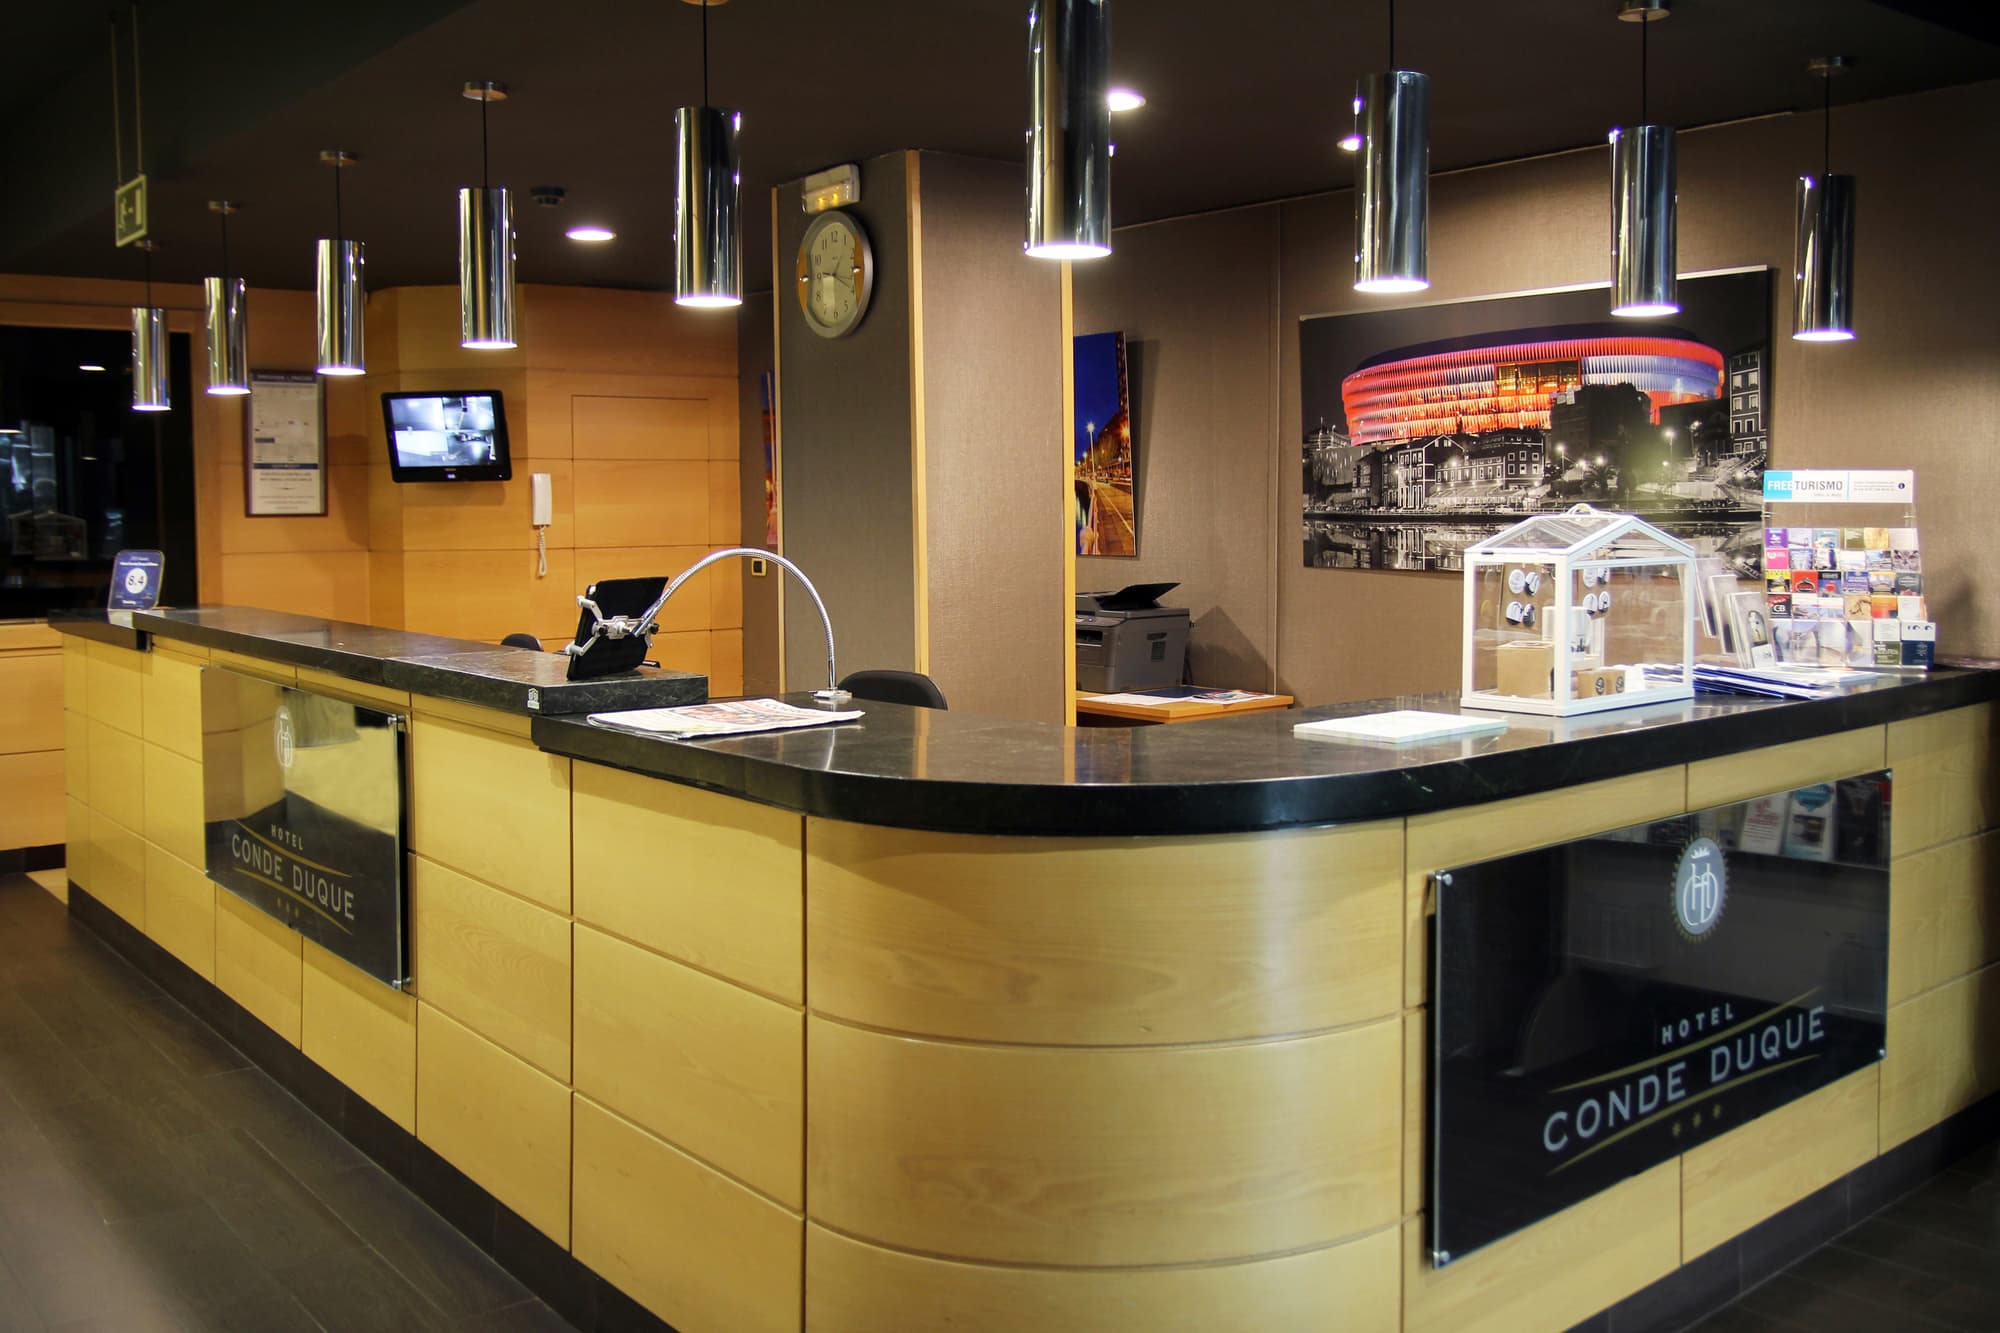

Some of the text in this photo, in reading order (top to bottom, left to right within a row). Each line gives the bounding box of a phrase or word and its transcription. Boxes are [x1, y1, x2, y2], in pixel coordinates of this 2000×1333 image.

[821, 239, 828, 250] 11
[831, 230, 838, 243] 12
[271, 824, 304, 851] HOTEL
[232, 833, 355, 921] CONDE DUQUE
[1661, 1002, 1735, 1044] HOTEL
[1542, 1006, 1826, 1153] CONDE DUQUE
